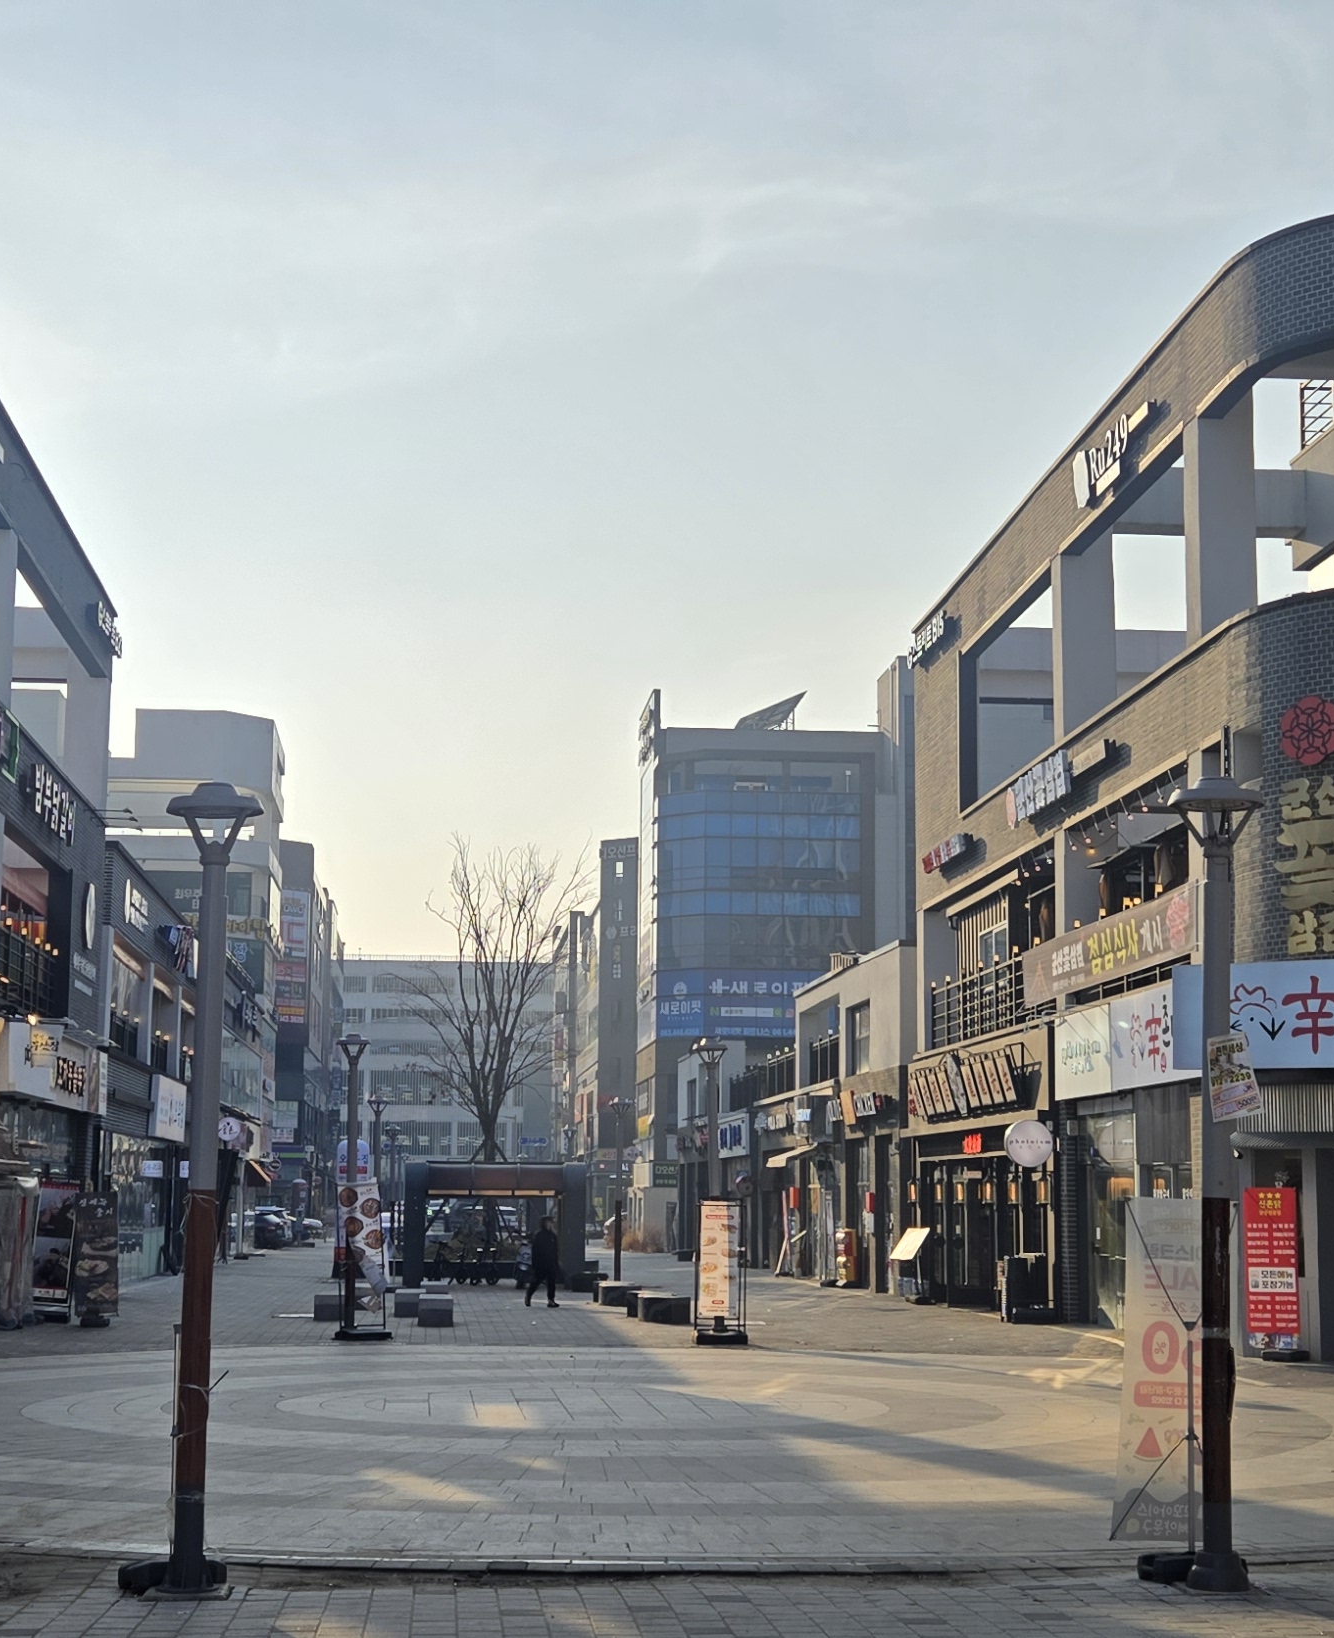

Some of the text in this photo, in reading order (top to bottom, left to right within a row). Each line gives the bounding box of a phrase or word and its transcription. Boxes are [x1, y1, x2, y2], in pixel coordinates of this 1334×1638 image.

[1087, 918, 1139, 976] 점심식사
[1140, 914, 1164, 954] 개시
[659, 999, 702, 1016] 새로이핏
[1009, 1138, 1052, 1146] photoism
[1260, 1279, 1294, 1290] 포장가능
